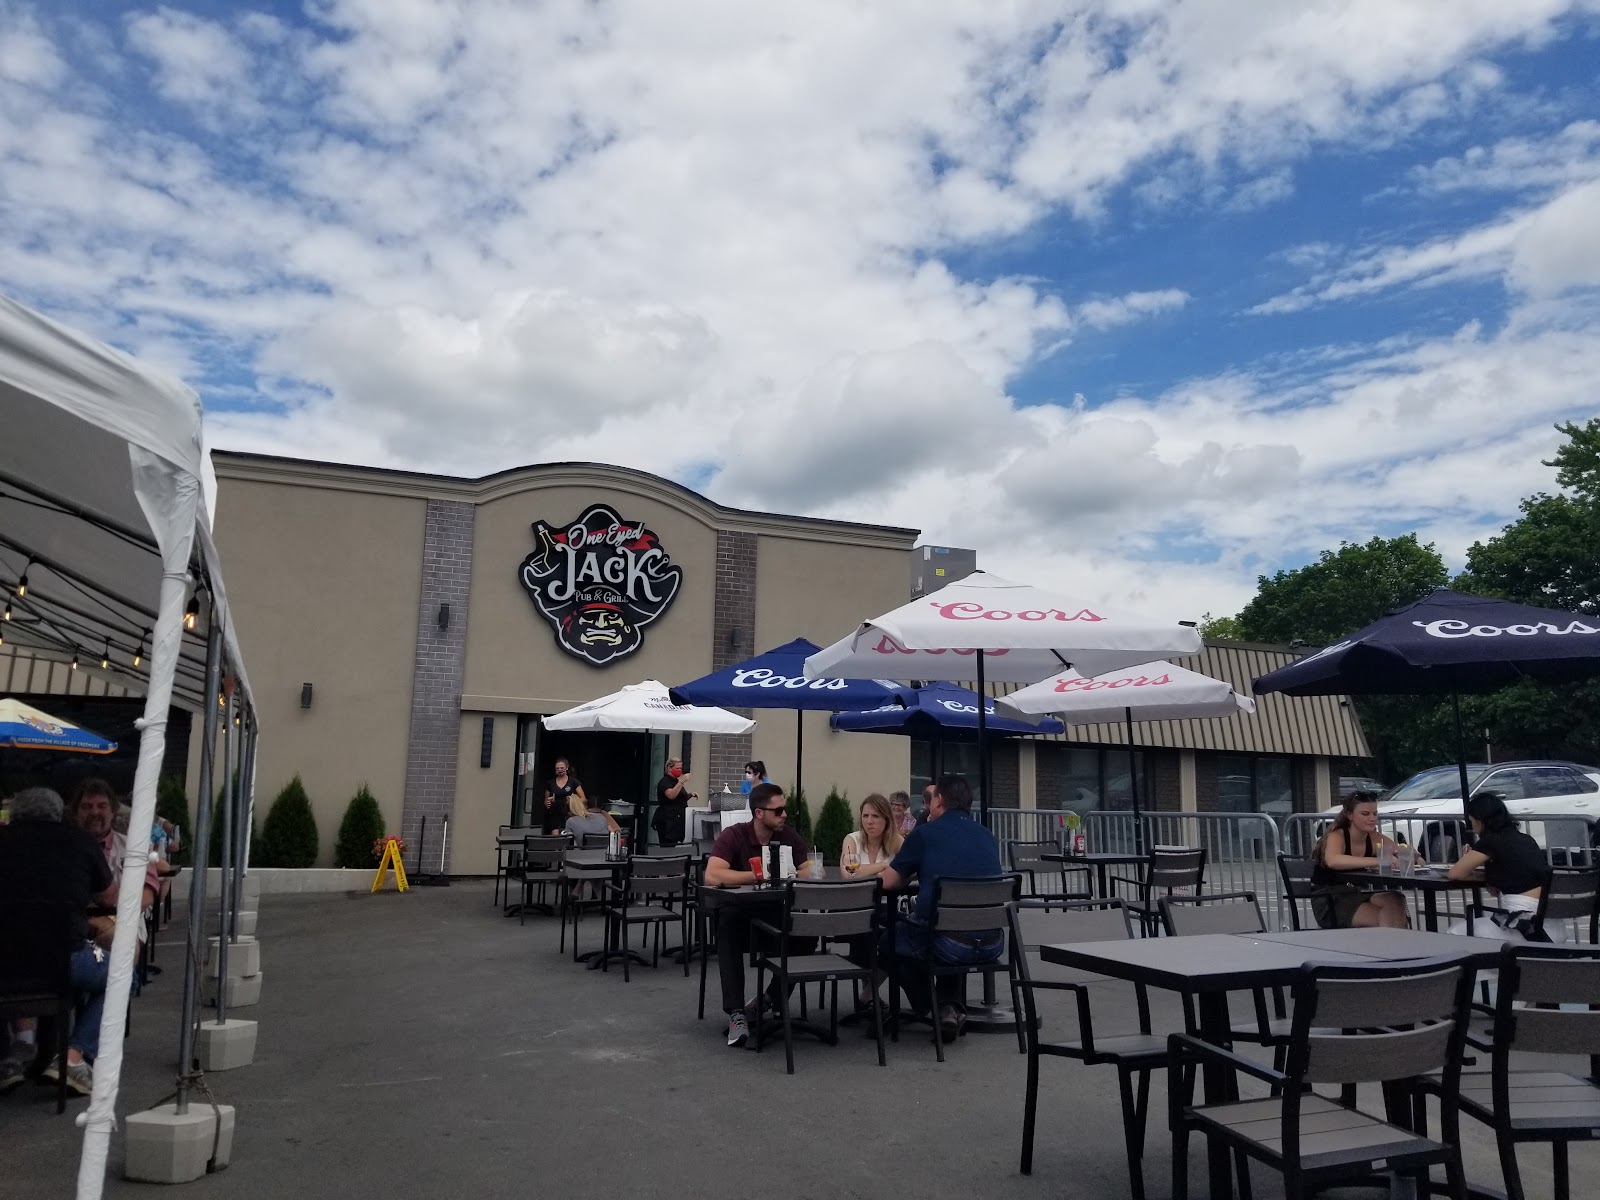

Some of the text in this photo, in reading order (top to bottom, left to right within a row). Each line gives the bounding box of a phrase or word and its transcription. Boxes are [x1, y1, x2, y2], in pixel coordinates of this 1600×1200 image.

[567, 522, 644, 550] One Eyed
[548, 543, 662, 602] JACK
[594, 589, 603, 601] &
[930, 602, 1107, 622] Coors
[1412, 619, 1600, 638] Coors
[731, 668, 848, 690] Coors
[1054, 673, 1173, 693] Coors
